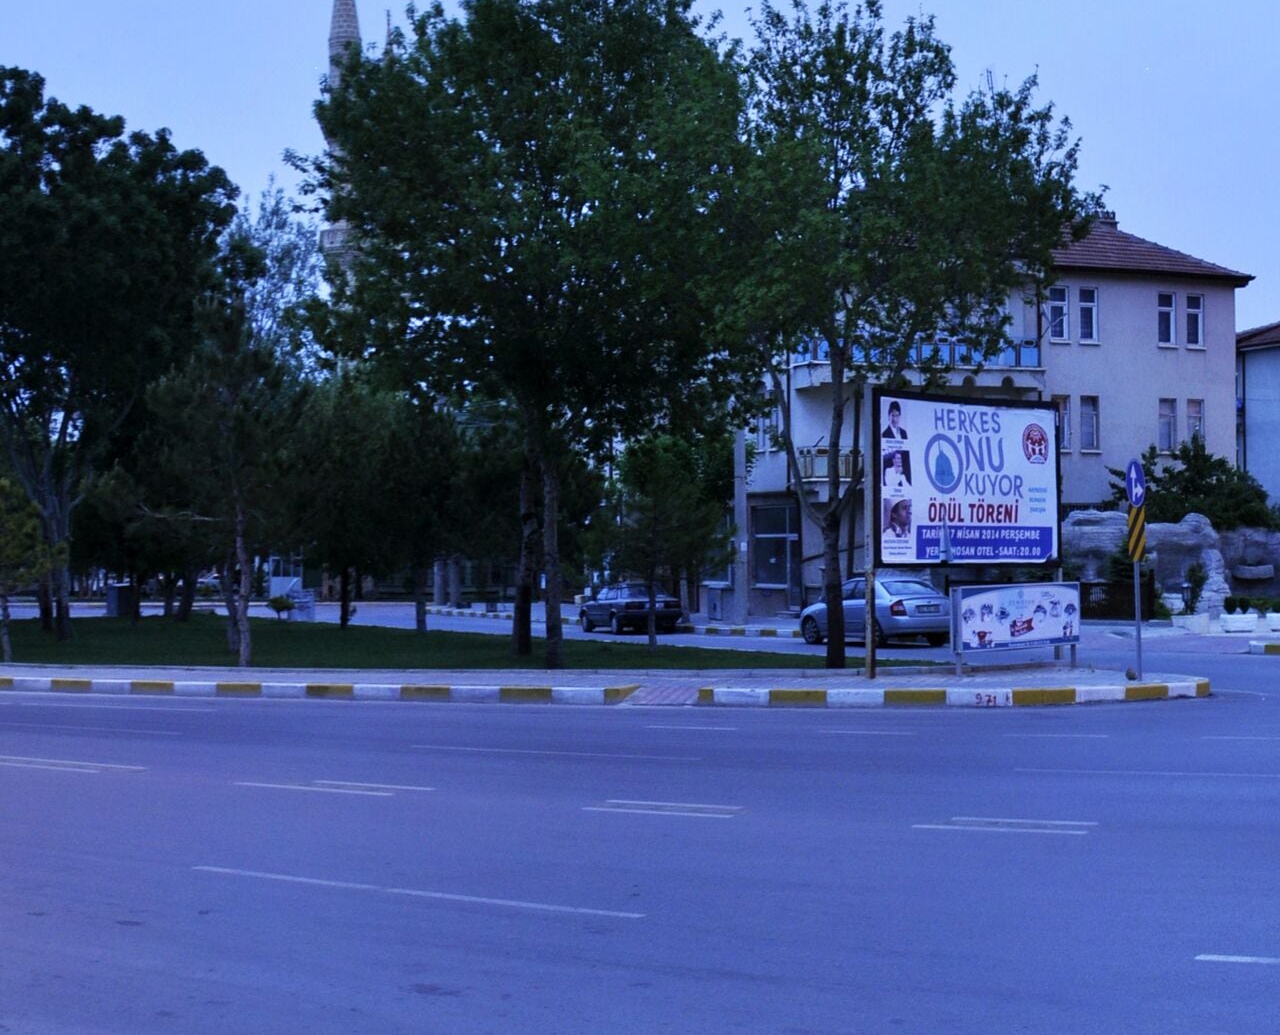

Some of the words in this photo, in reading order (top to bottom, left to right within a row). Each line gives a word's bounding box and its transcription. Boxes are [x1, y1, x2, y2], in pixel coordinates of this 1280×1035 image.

[934, 408, 1001, 434] HERKES
[964, 472, 1024, 498] KUYOR
[928, 497, 965, 522] ÖDÜL
[968, 499, 1019, 523] TÖRENİ
[957, 527, 980, 539] NİSAN
[982, 529, 999, 539] 2014
[1001, 529, 1040, 542] PERŞEMBE
